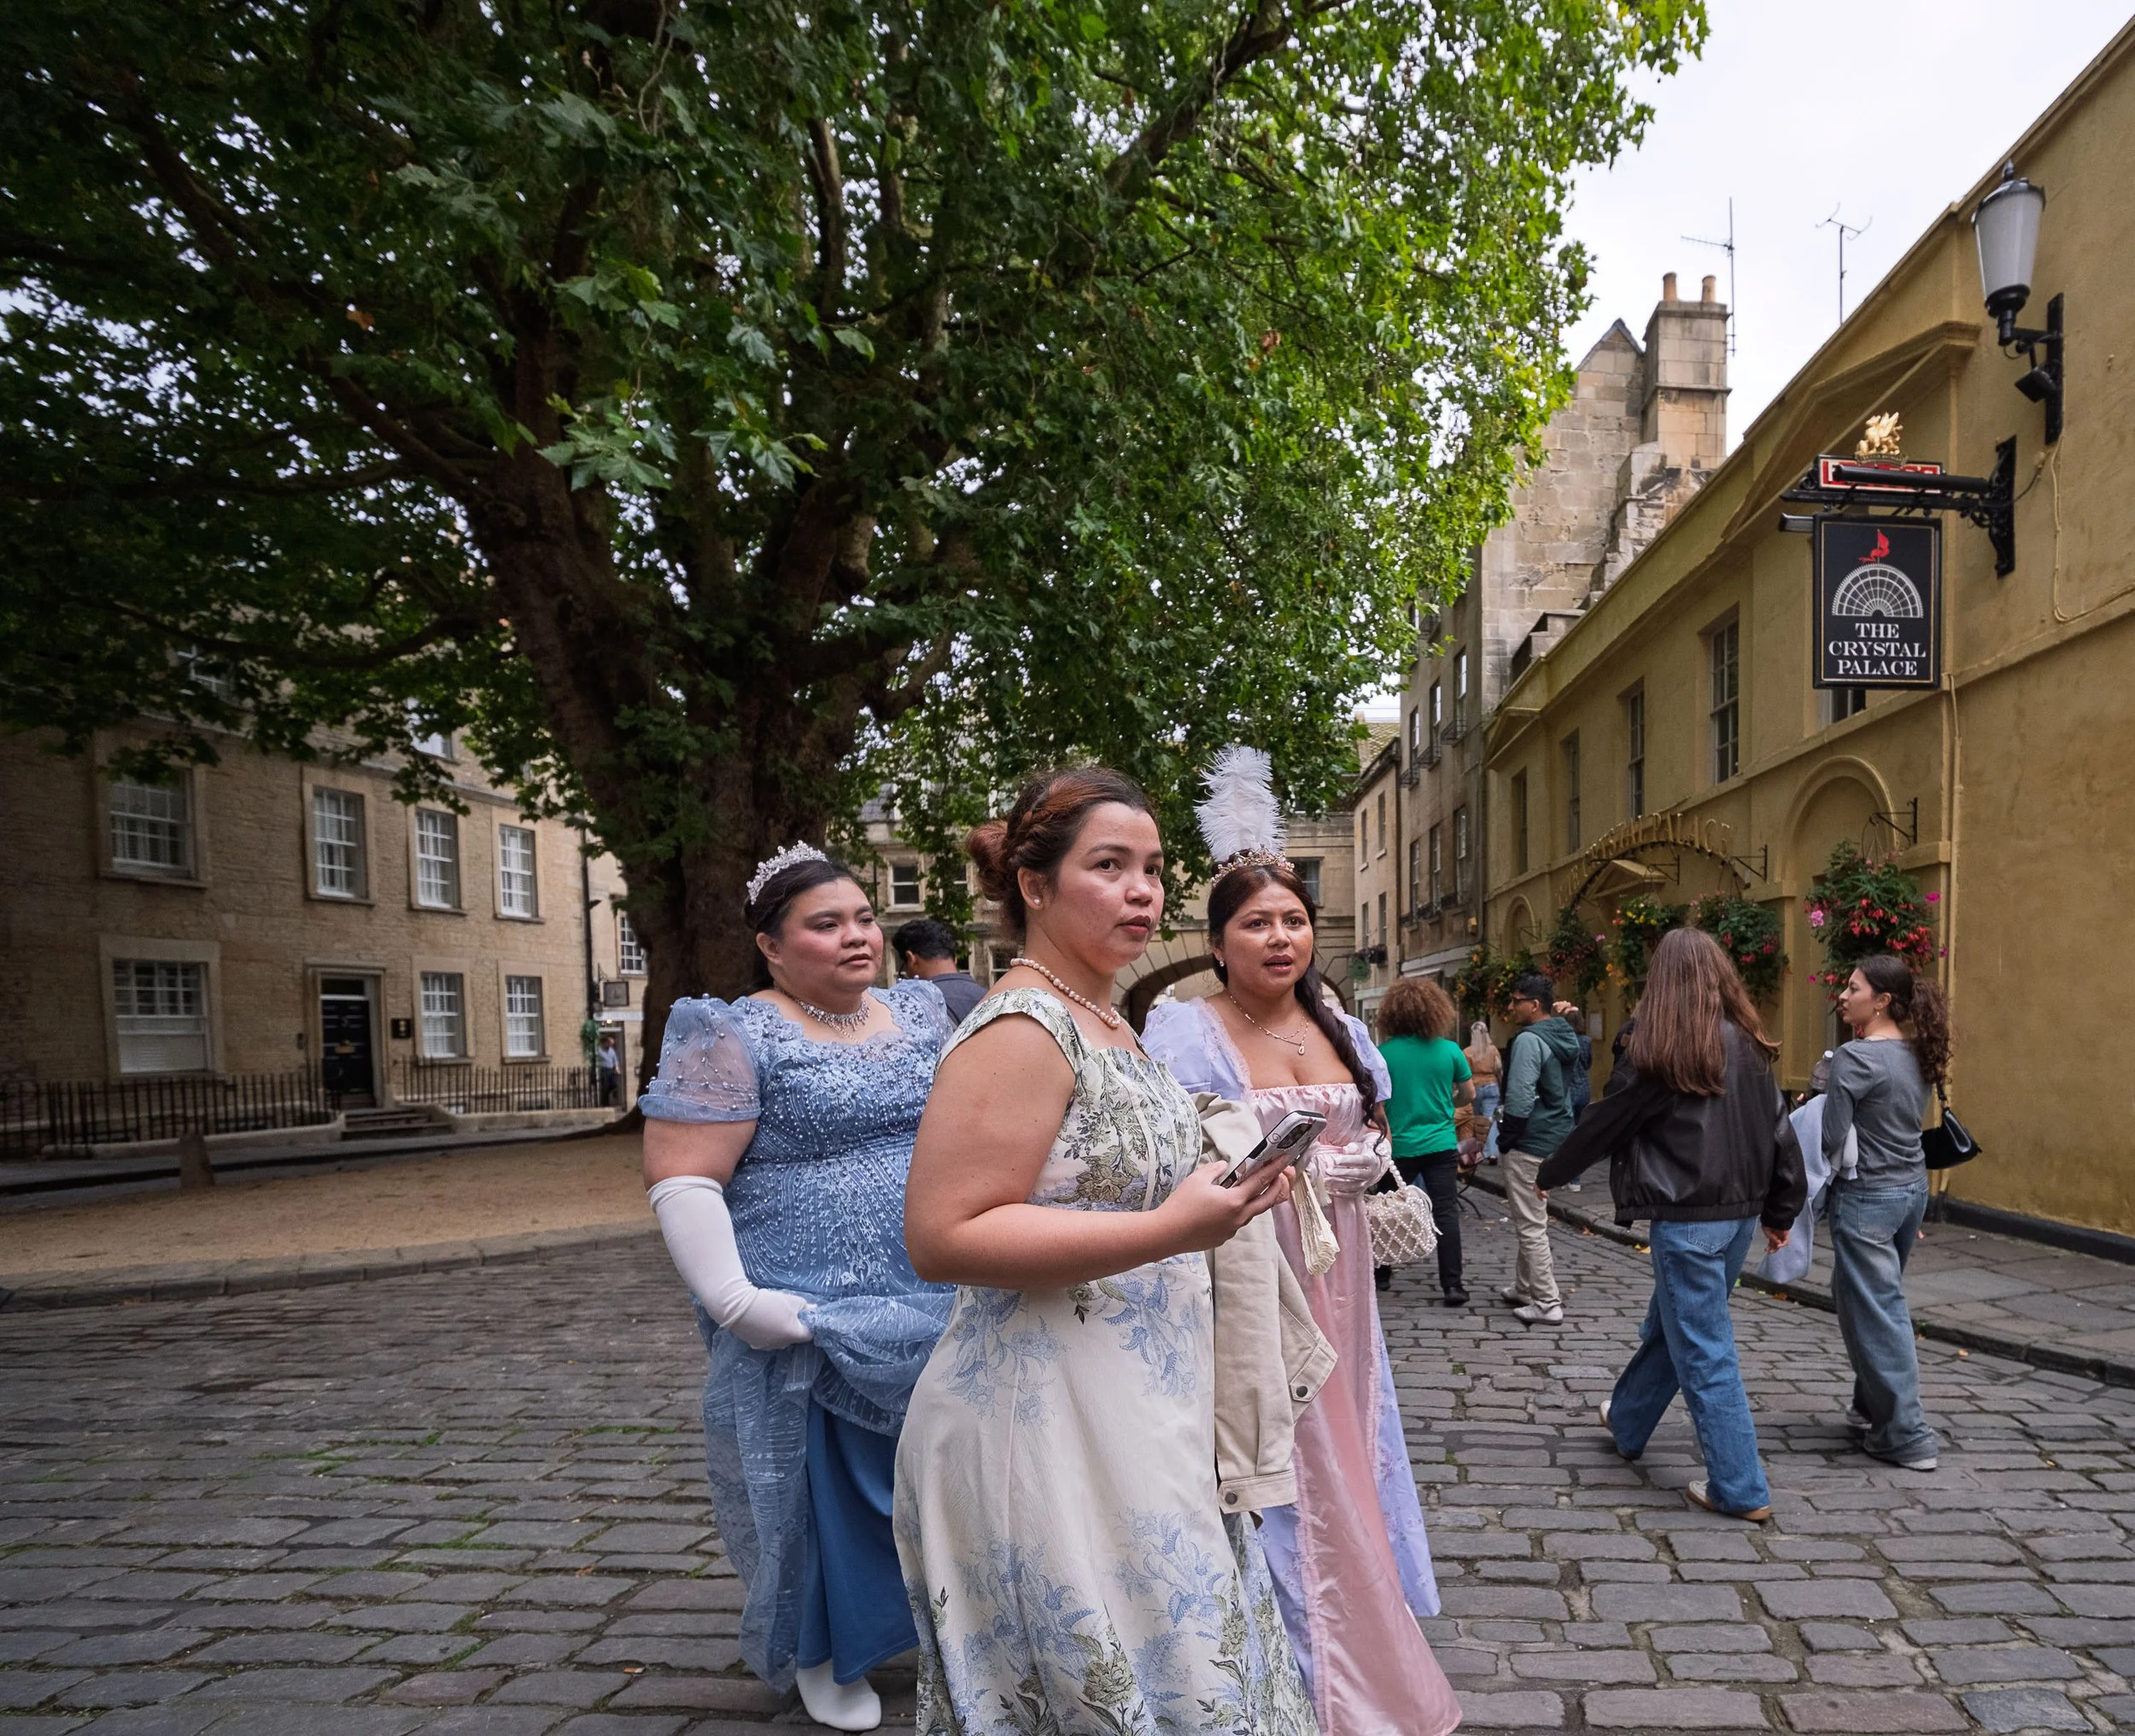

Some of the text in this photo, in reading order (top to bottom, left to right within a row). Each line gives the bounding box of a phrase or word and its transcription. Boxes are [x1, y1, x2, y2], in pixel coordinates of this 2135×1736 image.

[1855, 623, 1899, 639] THE
[1828, 640, 1927, 658] CRYSTAL
[1837, 659, 1917, 675] PALACE
